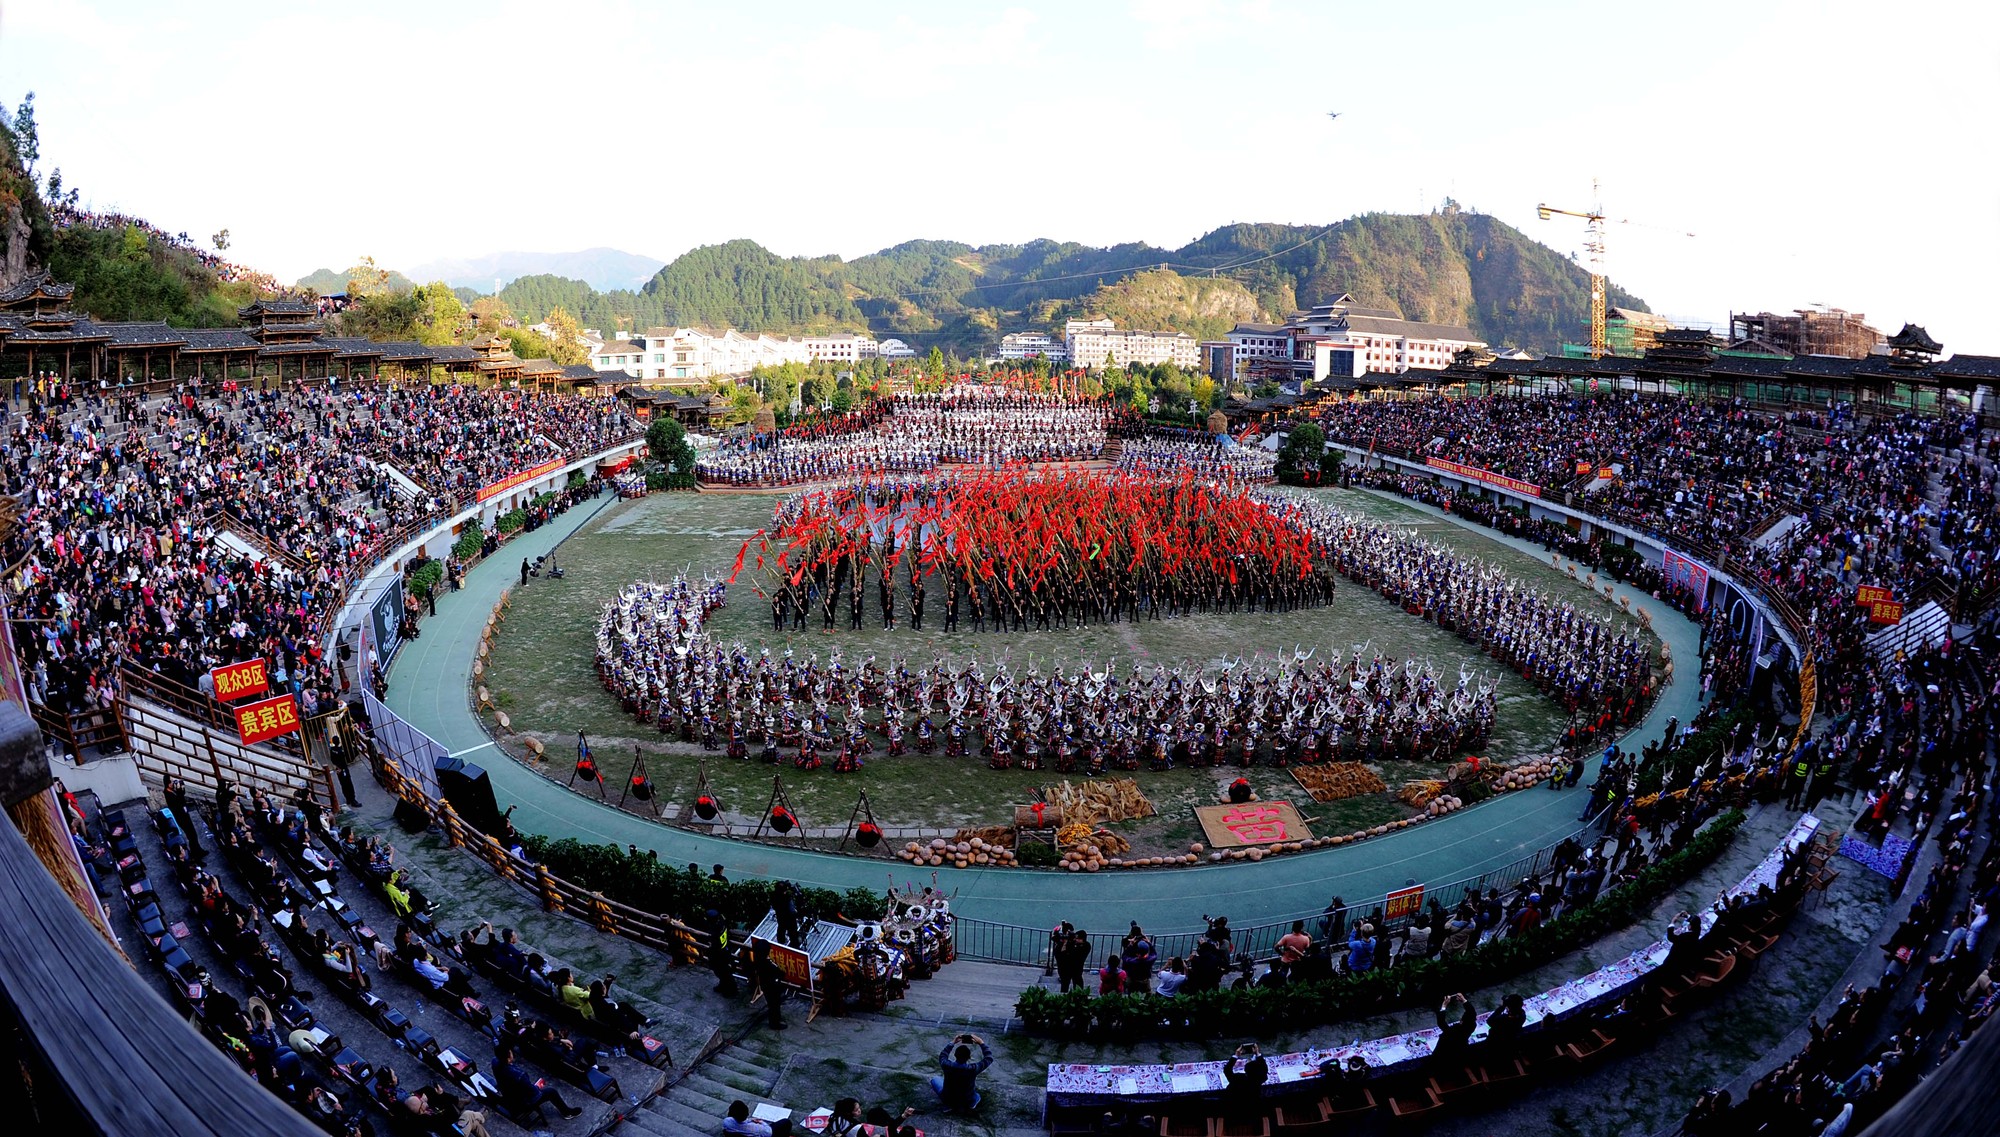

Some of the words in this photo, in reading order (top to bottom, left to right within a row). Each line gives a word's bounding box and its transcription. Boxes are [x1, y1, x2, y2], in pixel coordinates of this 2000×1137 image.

[1148, 396, 1160, 414] 苗
[1873, 602, 1901, 620] 贵宾区
[215, 664, 266, 694] 观众B区
[240, 701, 296, 737] 贵宾区
[1222, 806, 1289, 844] 苗
